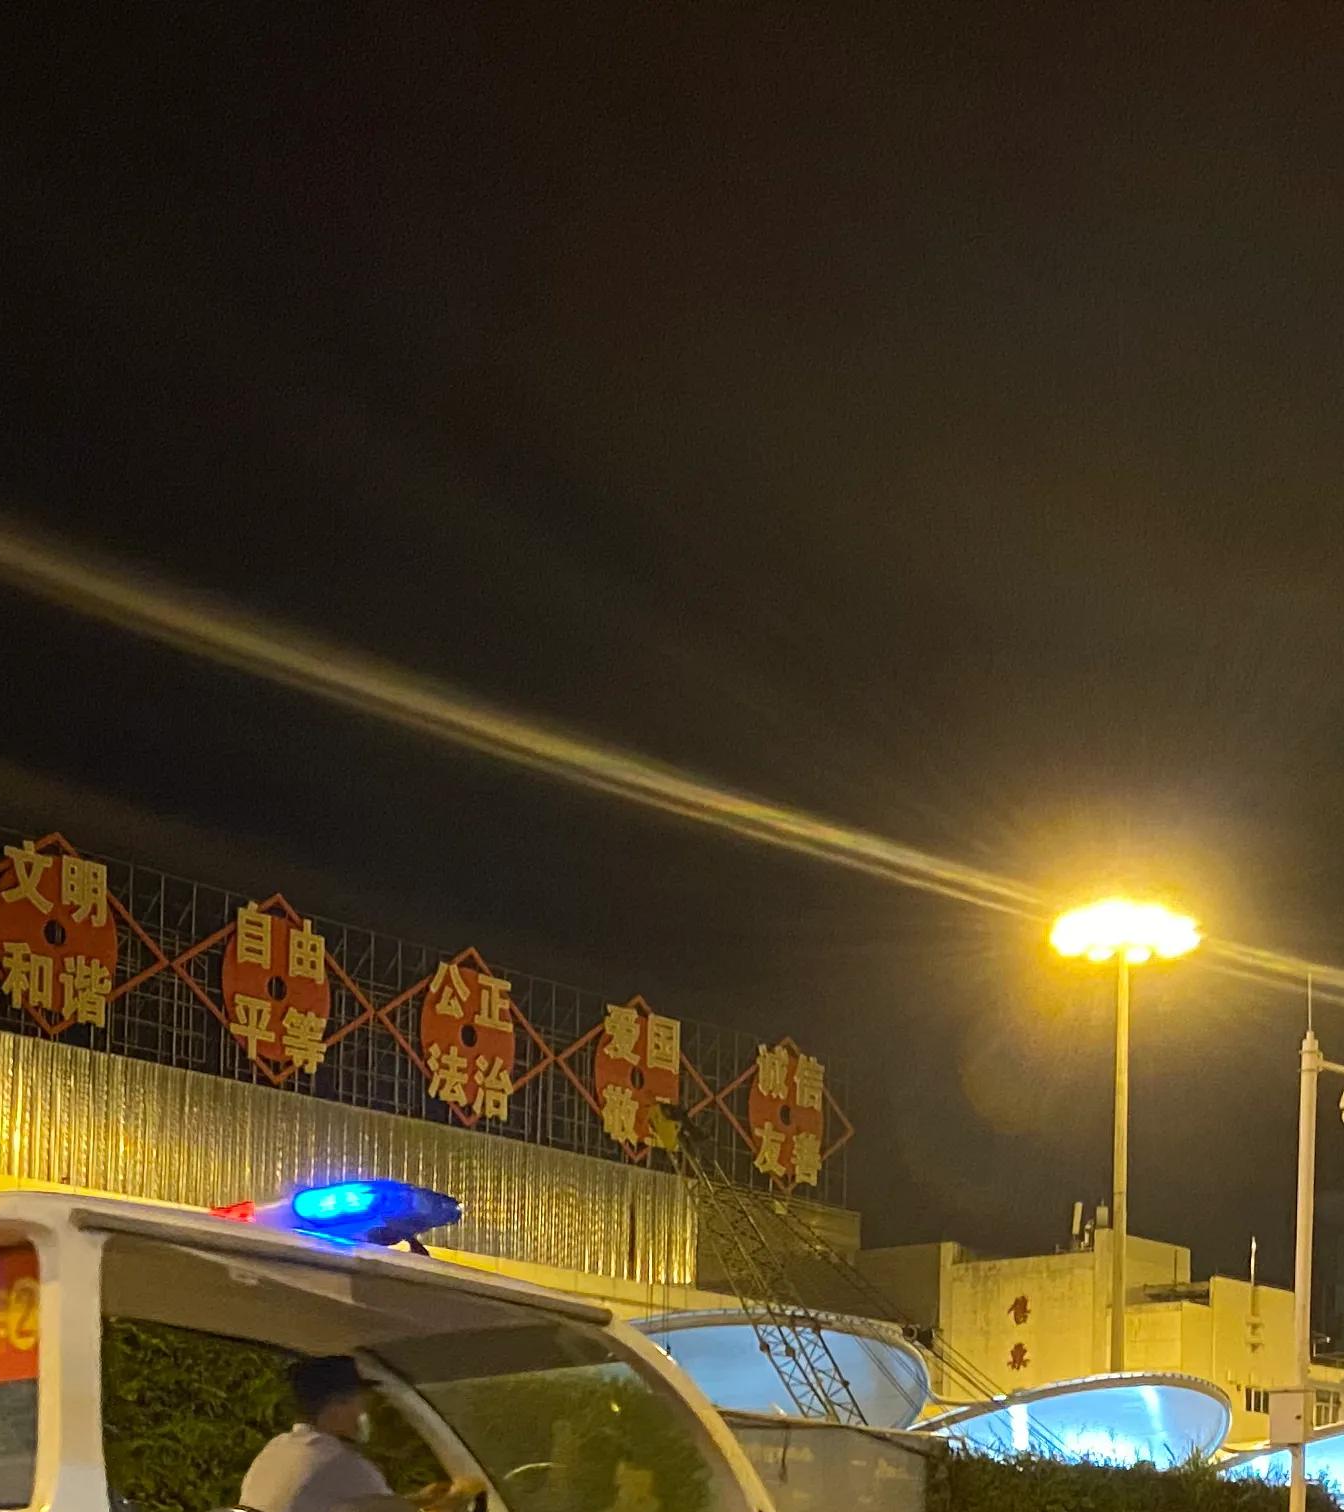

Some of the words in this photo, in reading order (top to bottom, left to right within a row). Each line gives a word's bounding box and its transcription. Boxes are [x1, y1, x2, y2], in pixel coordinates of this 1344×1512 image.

[3, 840, 107, 926] 文明
[236, 901, 325, 985] 自由
[2, 941, 111, 1028] 和谐
[430, 962, 513, 1032] 公正
[230, 993, 327, 1074] 平等
[604, 1004, 680, 1074] 爱国
[427, 1044, 513, 1122] 法治
